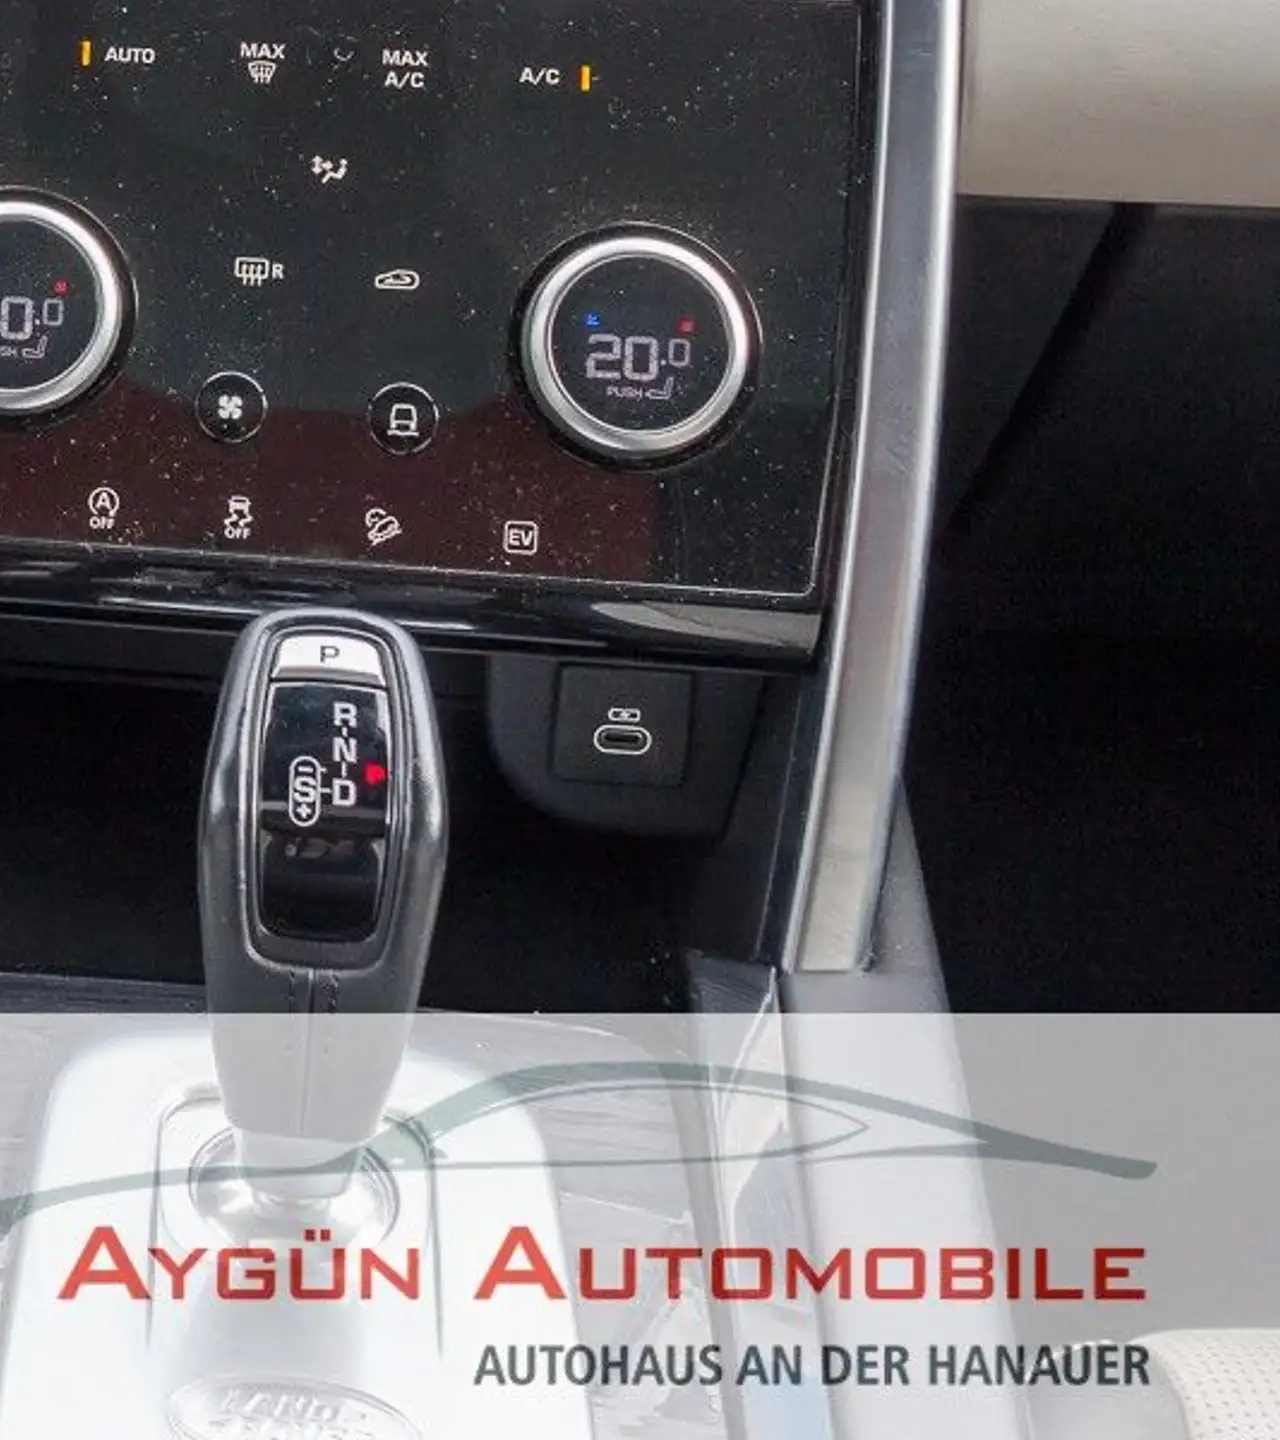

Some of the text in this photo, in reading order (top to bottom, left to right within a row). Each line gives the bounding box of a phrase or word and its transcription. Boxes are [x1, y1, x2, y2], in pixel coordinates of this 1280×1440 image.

[104, 46, 156, 64] AUTO
[240, 43, 286, 60] MAX
[382, 50, 429, 67] MAX
[384, 72, 425, 88] A/C
[519, 68, 560, 85] A/C
[272, 264, 284, 280] R
[585, 333, 690, 381] 20.0
[606, 386, 643, 399] PUSH
[89, 516, 115, 529] OFF
[224, 526, 252, 539] OFF
[509, 530, 534, 546] EV
[320, 645, 340, 662] P
[333, 702, 357, 727] R
[332, 738, 357, 763] N
[293, 776, 316, 803] S
[332, 779, 357, 806] D
